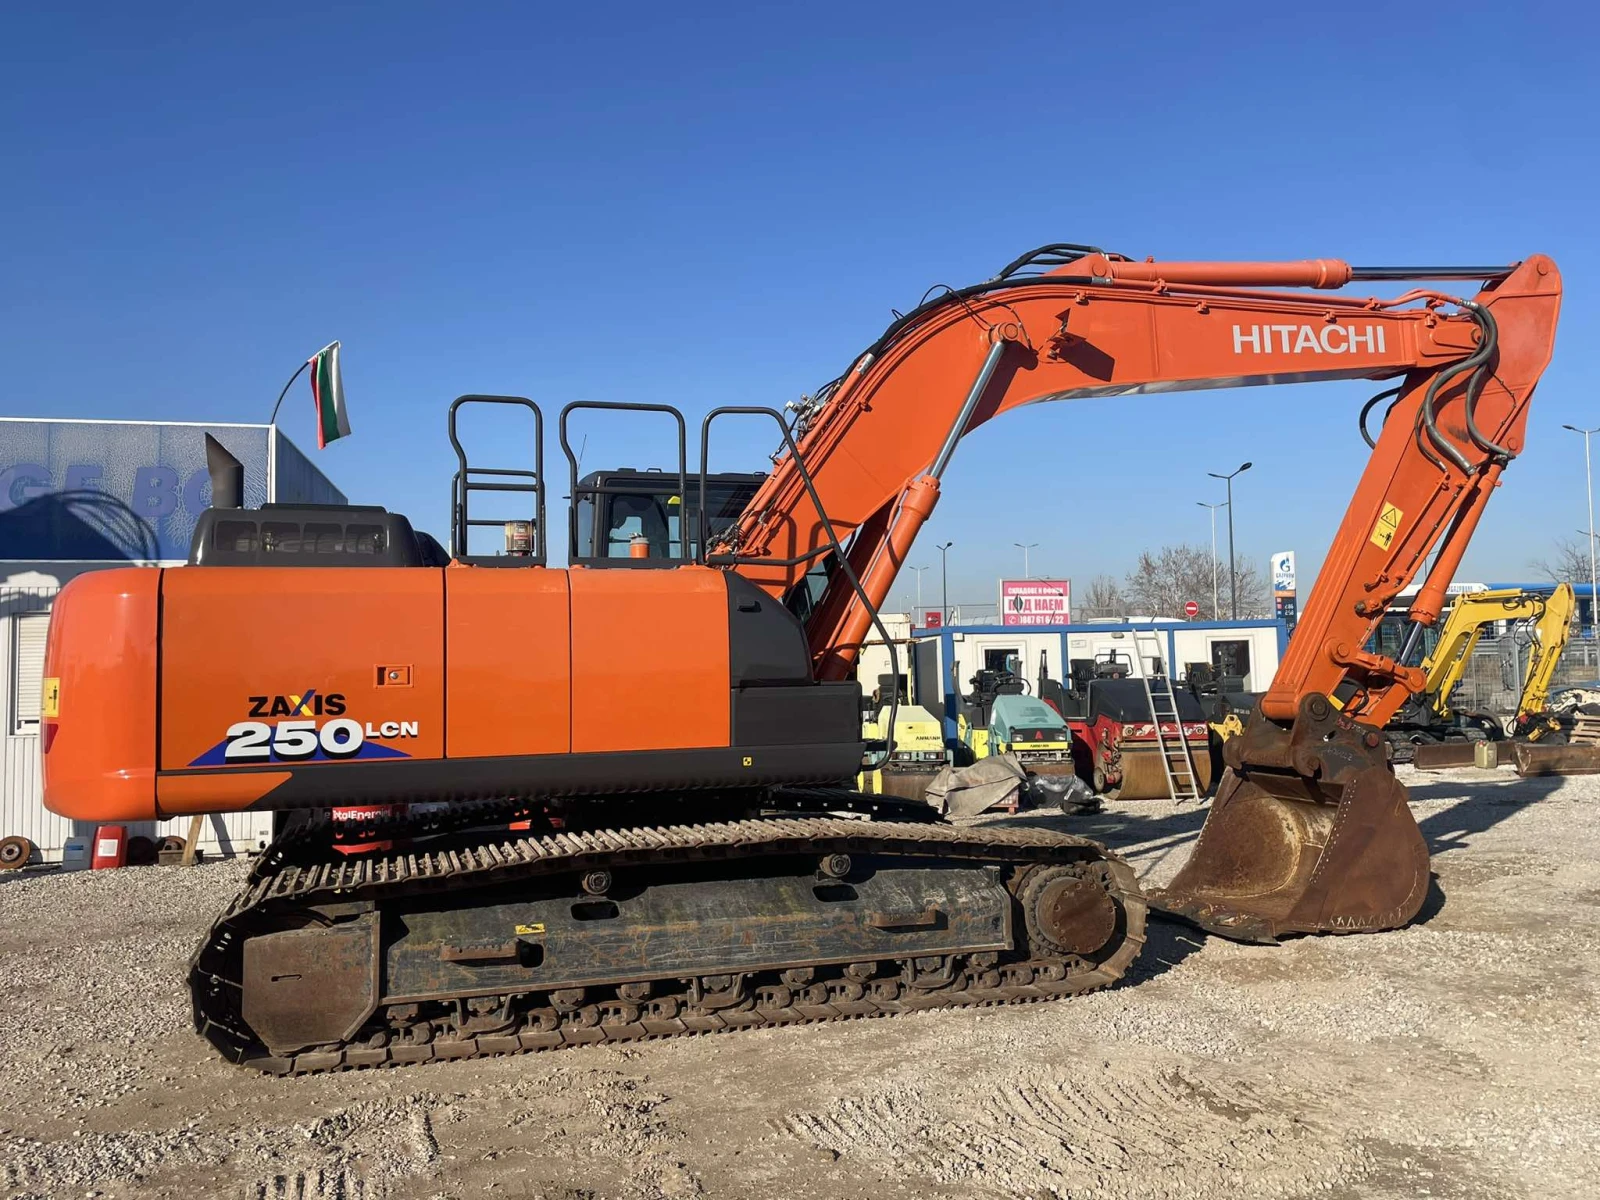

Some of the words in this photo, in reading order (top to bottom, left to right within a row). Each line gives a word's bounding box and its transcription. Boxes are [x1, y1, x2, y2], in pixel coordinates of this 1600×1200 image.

[1232, 324, 1386, 353] HITACHI
[1008, 599, 1032, 612] ПД
[1034, 599, 1064, 611] НАЕМ
[1055, 615, 1064, 624] 22
[249, 689, 347, 718] ZAXIS
[225, 718, 364, 763] 250
[366, 721, 419, 739] LCN
